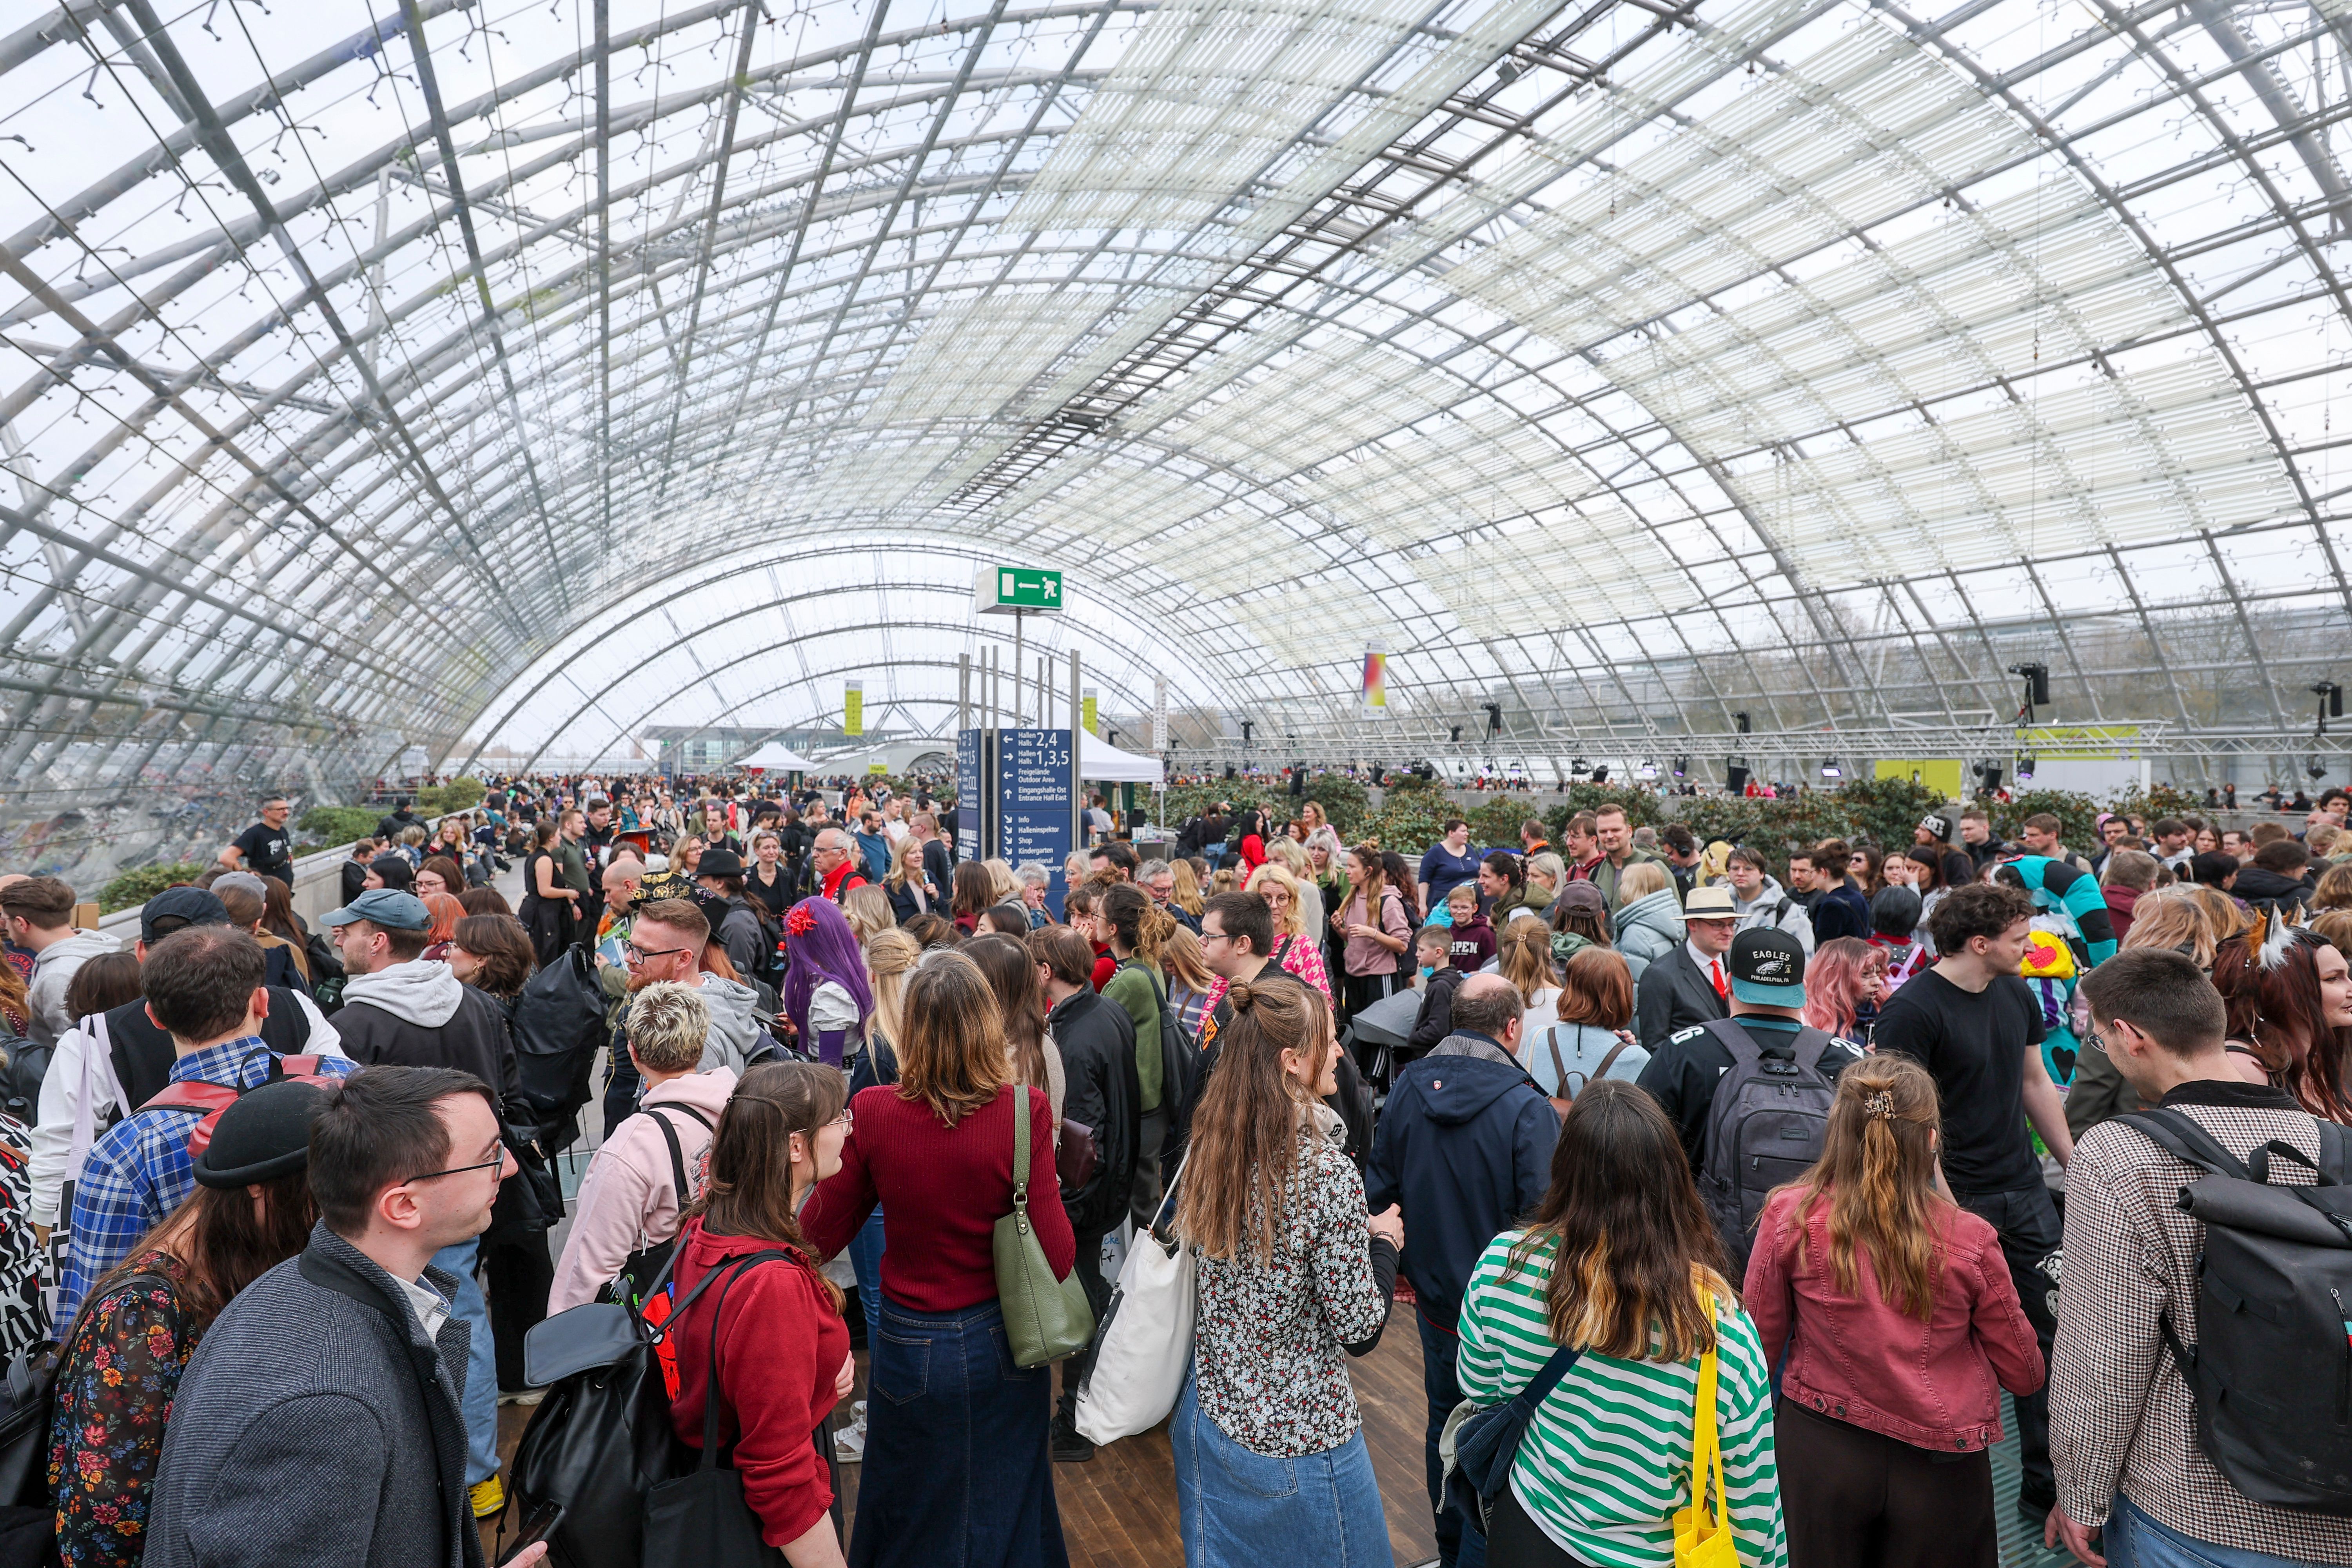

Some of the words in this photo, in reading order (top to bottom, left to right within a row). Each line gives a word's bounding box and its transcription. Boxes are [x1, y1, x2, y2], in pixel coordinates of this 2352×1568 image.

[968, 732, 972, 746] 3
[1036, 732, 1058, 749] 2,4
[1036, 750, 1069, 767] 1,3,5
[1018, 768, 1050, 777] Freigelände
[1018, 786, 1056, 795] Eingangshalle
[1018, 826, 1060, 834] Halleninspektor
[1018, 837, 1033, 845] Shop
[1018, 847, 1053, 855] Kindergarten
[1450, 941, 1478, 954] SPEN
[1752, 950, 1791, 961] EAGLES
[1669, 1025, 1705, 1045] 6
[1829, 1037, 1864, 1060] 2
[1101, 1233, 1120, 1245] cke
[1101, 1249, 1115, 1267] ft
